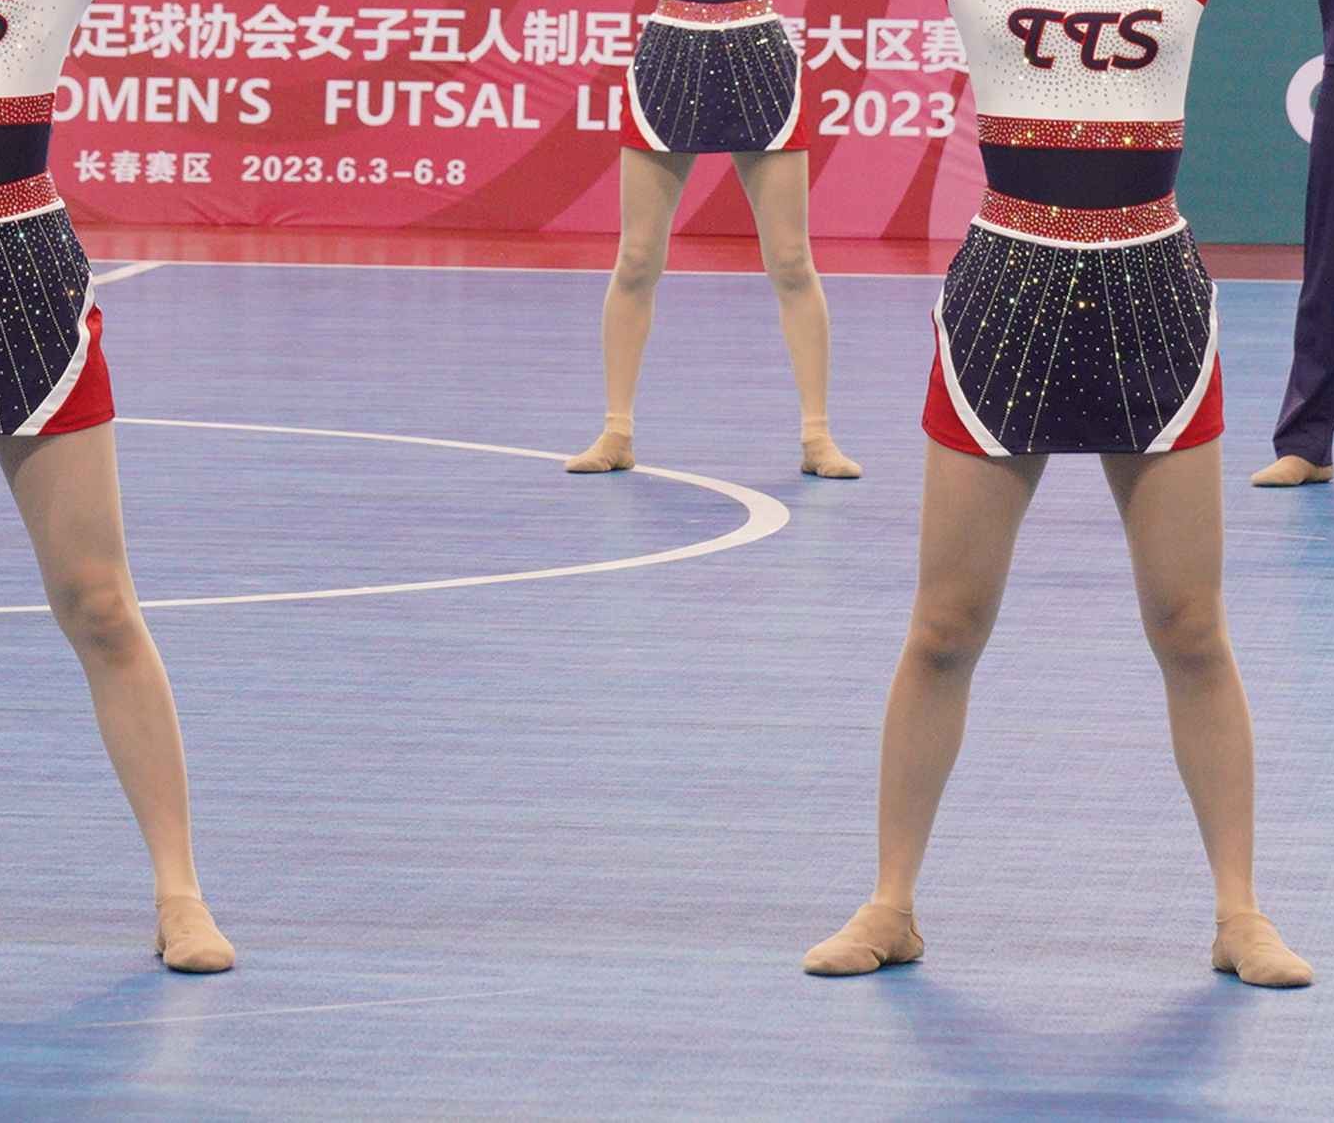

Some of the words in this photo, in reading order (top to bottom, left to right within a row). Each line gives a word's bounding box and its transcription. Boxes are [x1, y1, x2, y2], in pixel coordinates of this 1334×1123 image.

[1008, 8, 1164, 72] TTS
[52, 77, 271, 125] OMEN'S
[325, 79, 540, 129] FUTSAL
[819, 89, 957, 139] 2023
[73, 150, 212, 184] 长春赛区
[242, 155, 467, 187] 2023.6.3-6.8
